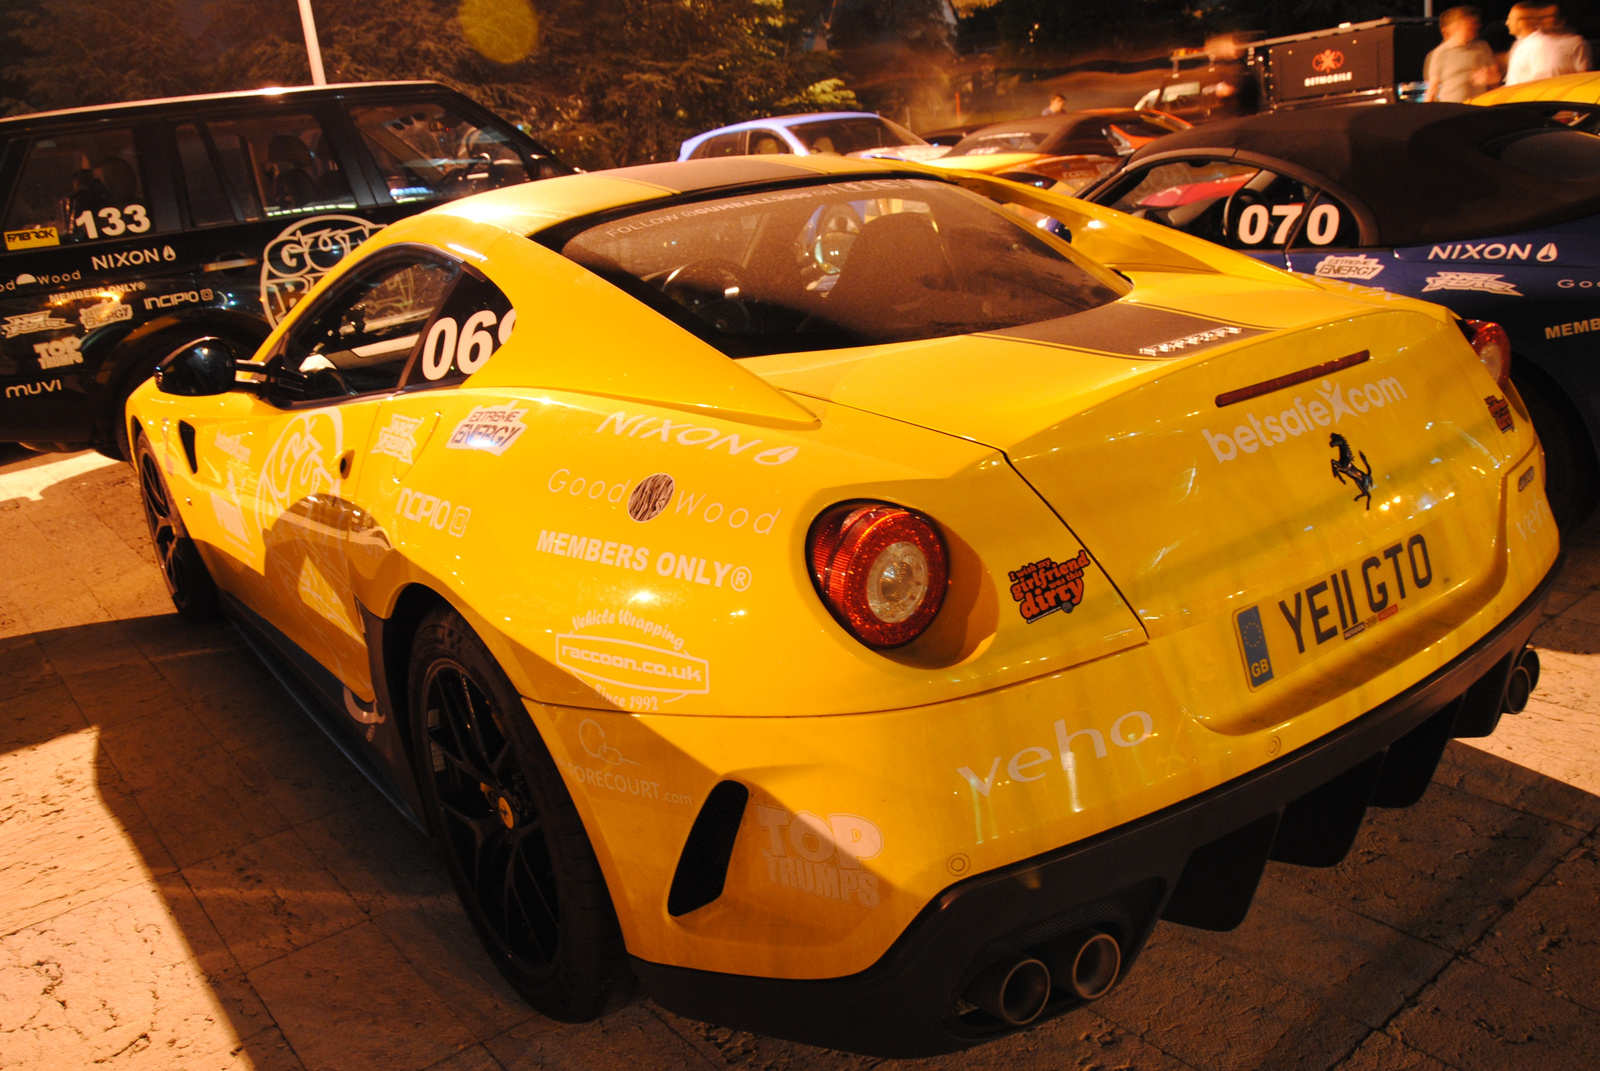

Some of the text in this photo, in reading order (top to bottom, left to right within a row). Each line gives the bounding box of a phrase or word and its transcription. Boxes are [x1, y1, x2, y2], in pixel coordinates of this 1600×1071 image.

[75, 204, 151, 239] 133
[605, 213, 679, 238] FOLLOW
[1238, 204, 1340, 245] 070
[91, 248, 160, 270] NIXON
[1428, 243, 1532, 260] NIXON
[36, 270, 82, 285] Wood
[1319, 264, 1380, 276] ENERGY
[1557, 279, 1600, 288] Go
[49, 286, 108, 303] MEMBERS
[143, 290, 200, 310] INCIPIO
[33, 335, 82, 358] TOP
[468, 411, 520, 422] EXTREME
[451, 424, 521, 447] ENERGY
[595, 411, 763, 455] NIXON
[548, 468, 782, 535] Good Wood
[1516, 491, 1551, 542] veh
[536, 529, 649, 572] MEMBERS
[1009, 559, 1051, 581] I wish my
[1011, 550, 1090, 601] girlfriend
[1049, 569, 1083, 589] was this
[1361, 533, 1433, 614] GTO
[1021, 578, 1084, 618] dirty
[572, 609, 685, 651] Vehicle Wrapping
[561, 645, 701, 682] raccoon.co.uk
[1251, 658, 1270, 678] GB
[594, 683, 659, 711] Since 1992
[955, 710, 1154, 797] veho
[754, 803, 884, 870] TOP
[762, 848, 880, 909] TRUMPS
